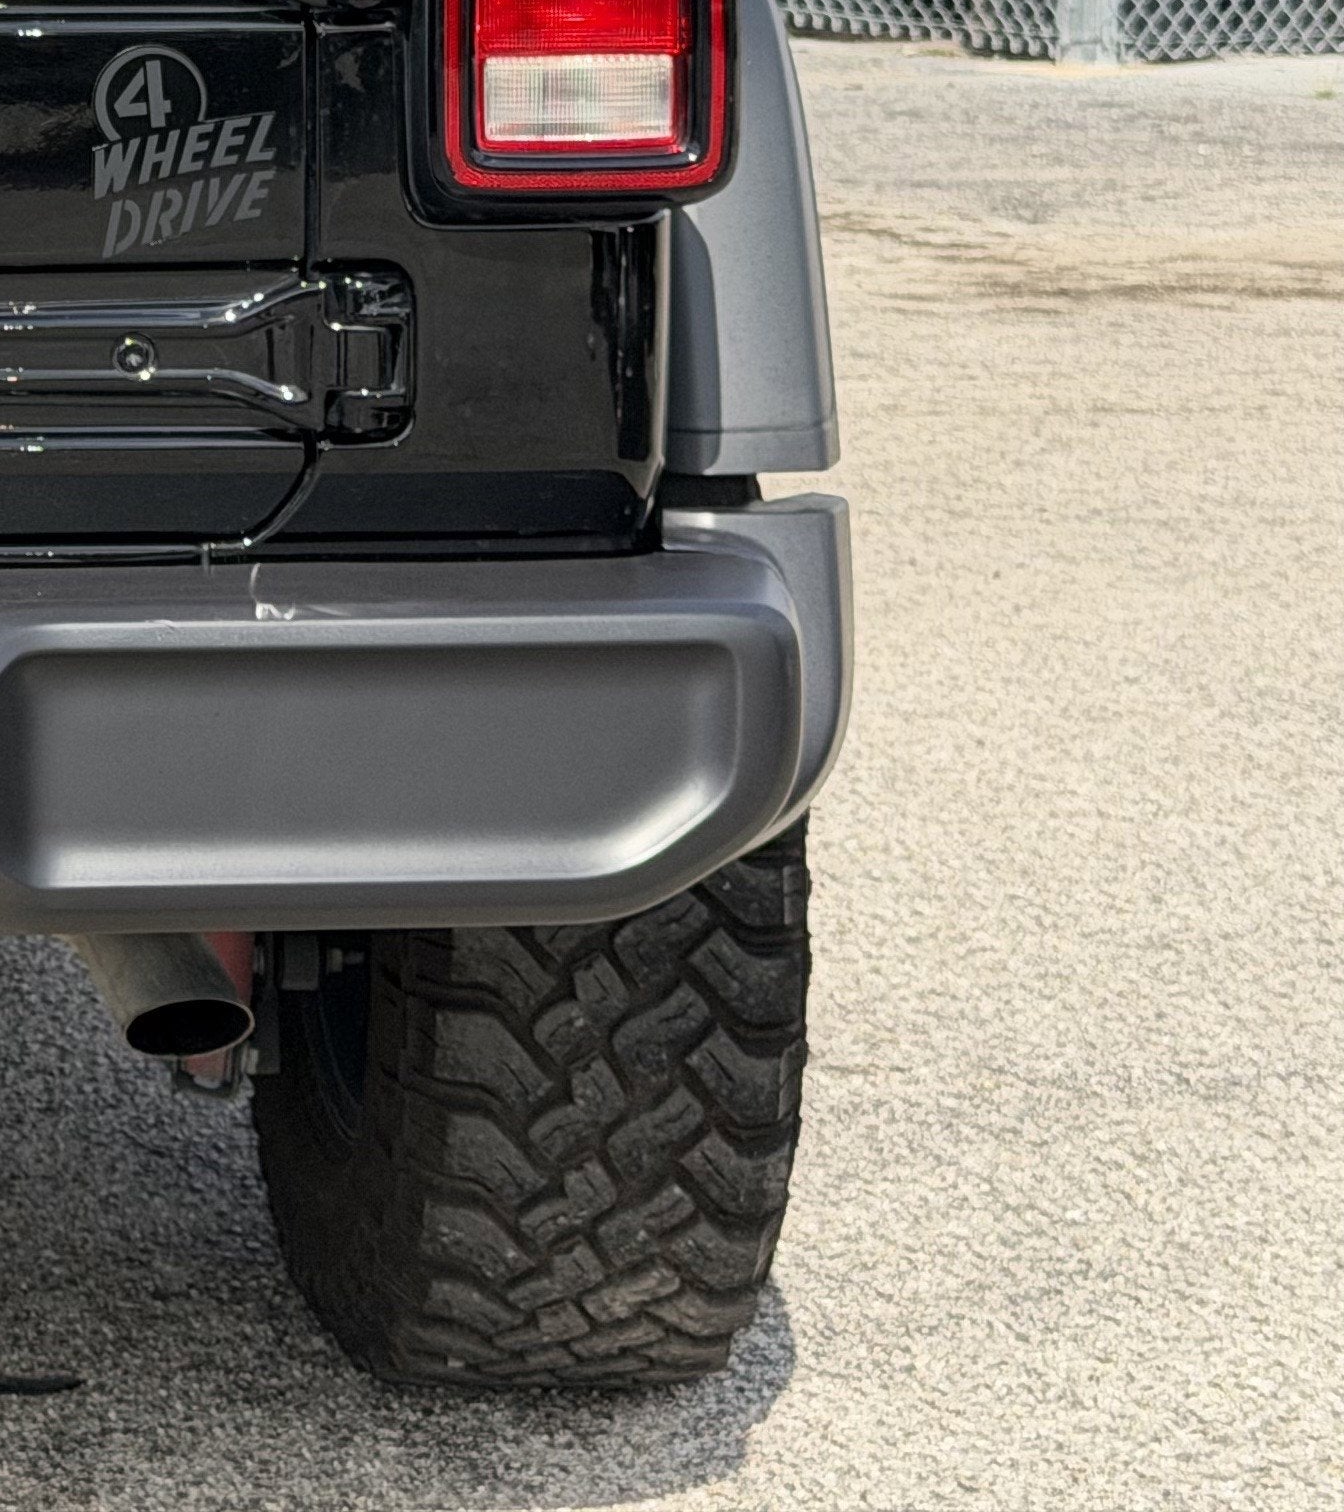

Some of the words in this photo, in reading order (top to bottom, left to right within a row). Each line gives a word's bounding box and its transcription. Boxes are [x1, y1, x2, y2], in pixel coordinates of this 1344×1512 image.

[113, 59, 172, 128] 4
[92, 110, 277, 201] WHEEL
[102, 166, 277, 259] DRIVE
